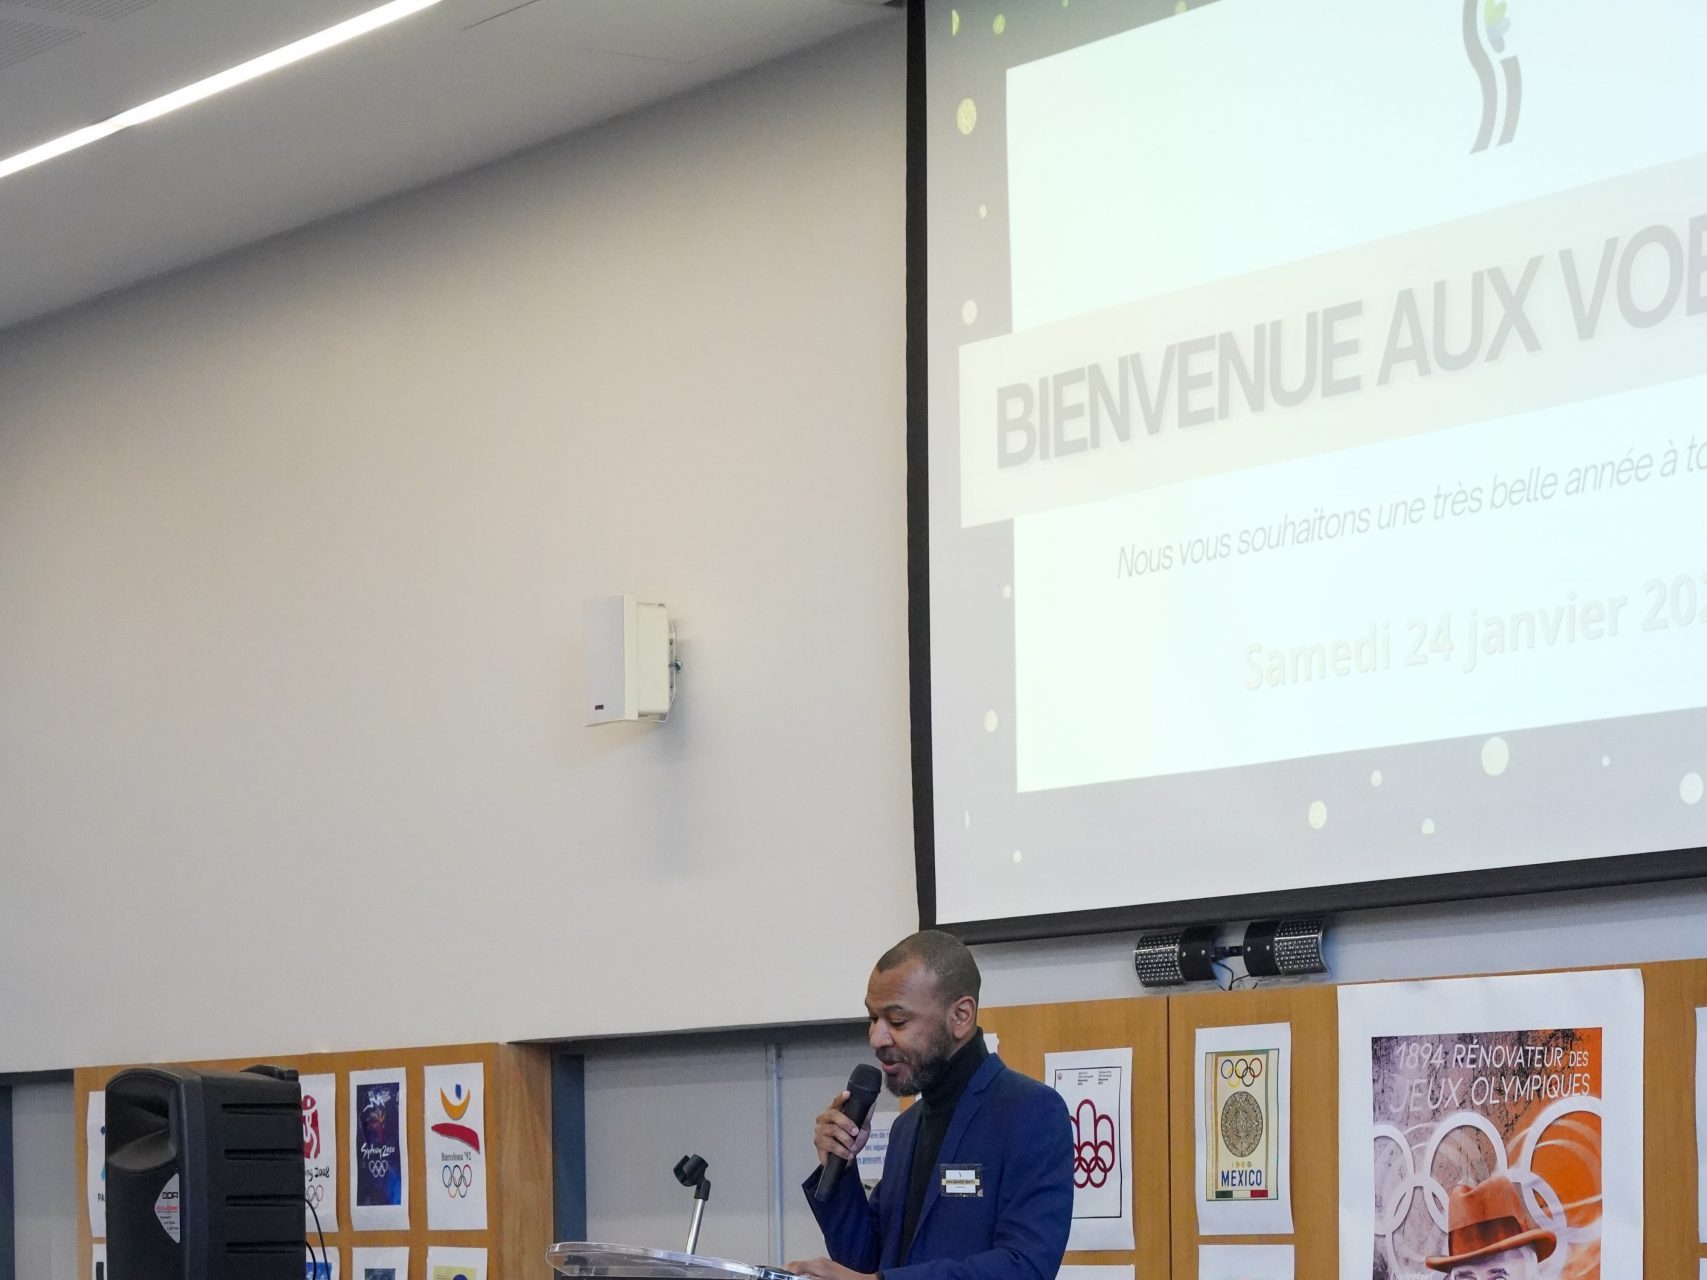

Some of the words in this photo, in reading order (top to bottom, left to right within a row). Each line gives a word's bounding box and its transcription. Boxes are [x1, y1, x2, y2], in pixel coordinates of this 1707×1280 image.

[996, 300, 1363, 469] BIENVENUE
[1376, 255, 1544, 387] AUX
[1117, 543, 1173, 579] Nous
[1179, 532, 1231, 566] vous
[1238, 506, 1371, 555] souhaitons
[1378, 497, 1426, 530] une
[1433, 481, 1484, 520] très
[1490, 466, 1558, 511] belle
[1564, 446, 1654, 495] année
[1660, 439, 1679, 478] à
[1243, 620, 1391, 691] Samedi
[1405, 612, 1456, 667] 24
[1462, 590, 1628, 674] janvier
[1397, 1041, 1445, 1070] 1894
[1452, 1039, 1563, 1069] RÉNOVATEUR
[1569, 1051, 1589, 1067] DES
[1388, 1074, 1463, 1113] JEUX
[1471, 1073, 1590, 1105] OLYMPIQUES
[1221, 1169, 1262, 1187] MEXICO
